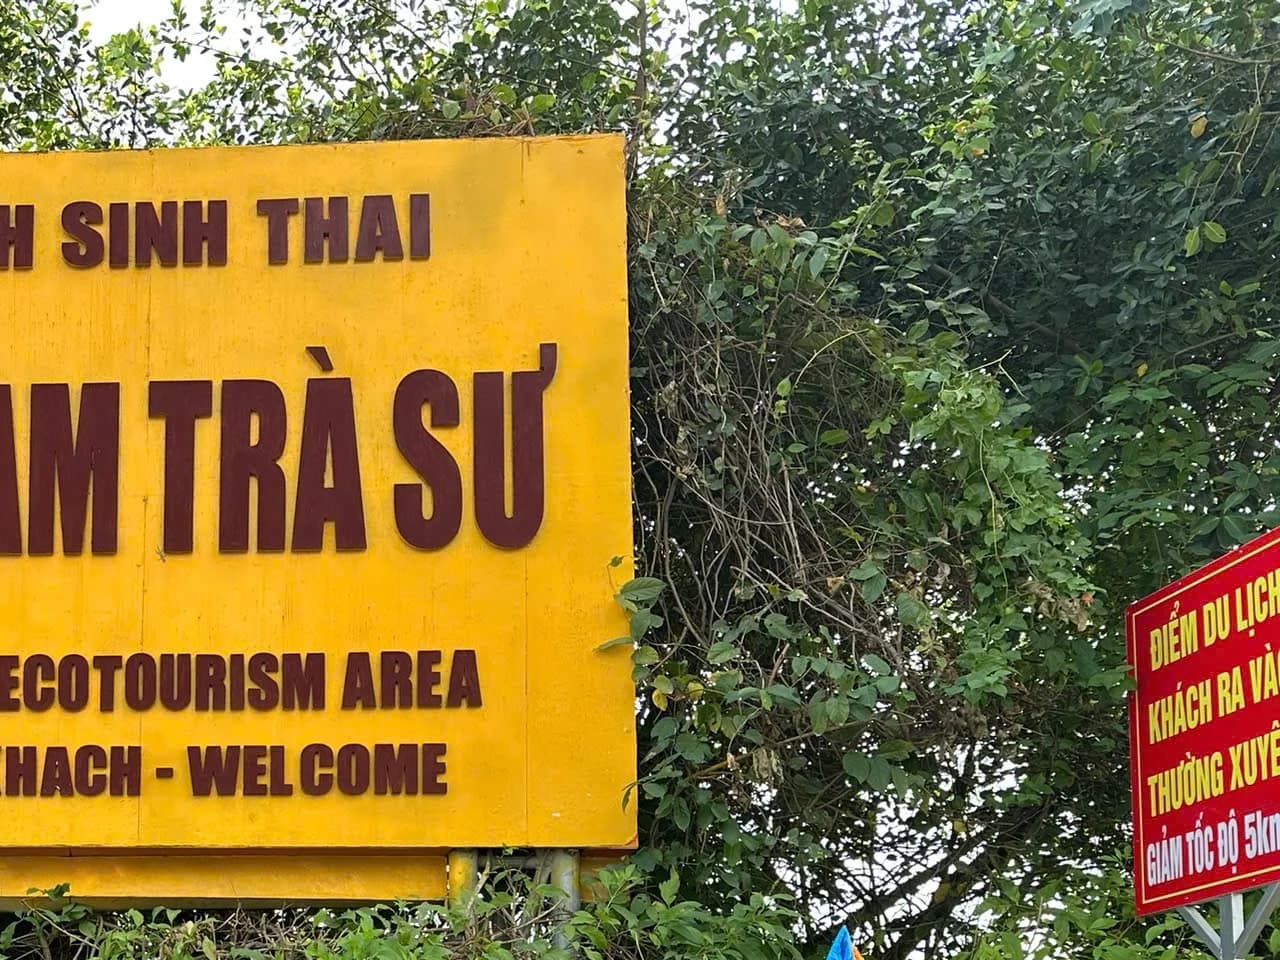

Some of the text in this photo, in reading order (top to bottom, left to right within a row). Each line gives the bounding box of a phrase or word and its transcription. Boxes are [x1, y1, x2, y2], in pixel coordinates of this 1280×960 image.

[61, 199, 228, 270] SINH
[257, 193, 431, 266] THAI
[147, 346, 368, 555] TRÀ
[392, 342, 558, 553] SƯ
[1149, 567, 1280, 672] ĐIỂM DU LỊCH
[341, 649, 483, 710] AREA
[1148, 642, 1280, 745] KHÁCH RA VÀ
[187, 743, 448, 797] WELCOME
[1147, 751, 1225, 817] THƯỜNG
[1147, 824, 1183, 887] GIẢM
[1186, 811, 1214, 875] TỐC
[1217, 808, 1239, 874] ĐỘ
